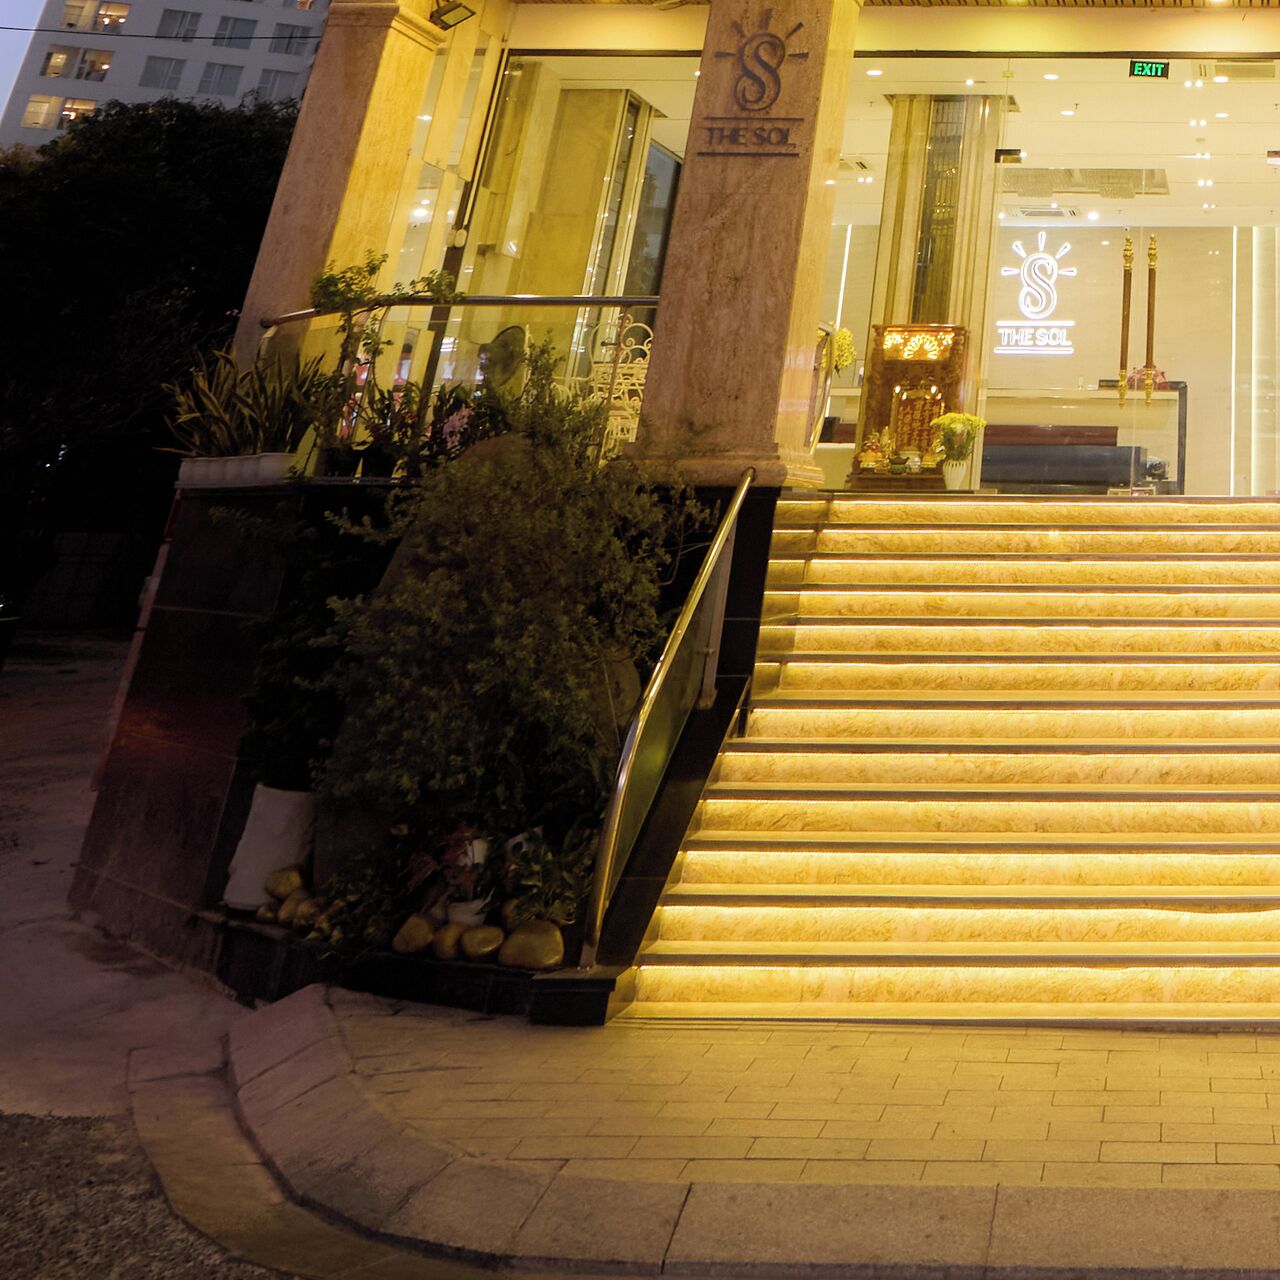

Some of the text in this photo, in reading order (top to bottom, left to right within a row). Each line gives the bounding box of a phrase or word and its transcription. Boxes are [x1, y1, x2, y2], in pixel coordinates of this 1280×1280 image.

[1134, 63, 1164, 76] EXIT
[706, 127, 797, 148] THE SOL
[997, 327, 1073, 346] THE SOL
